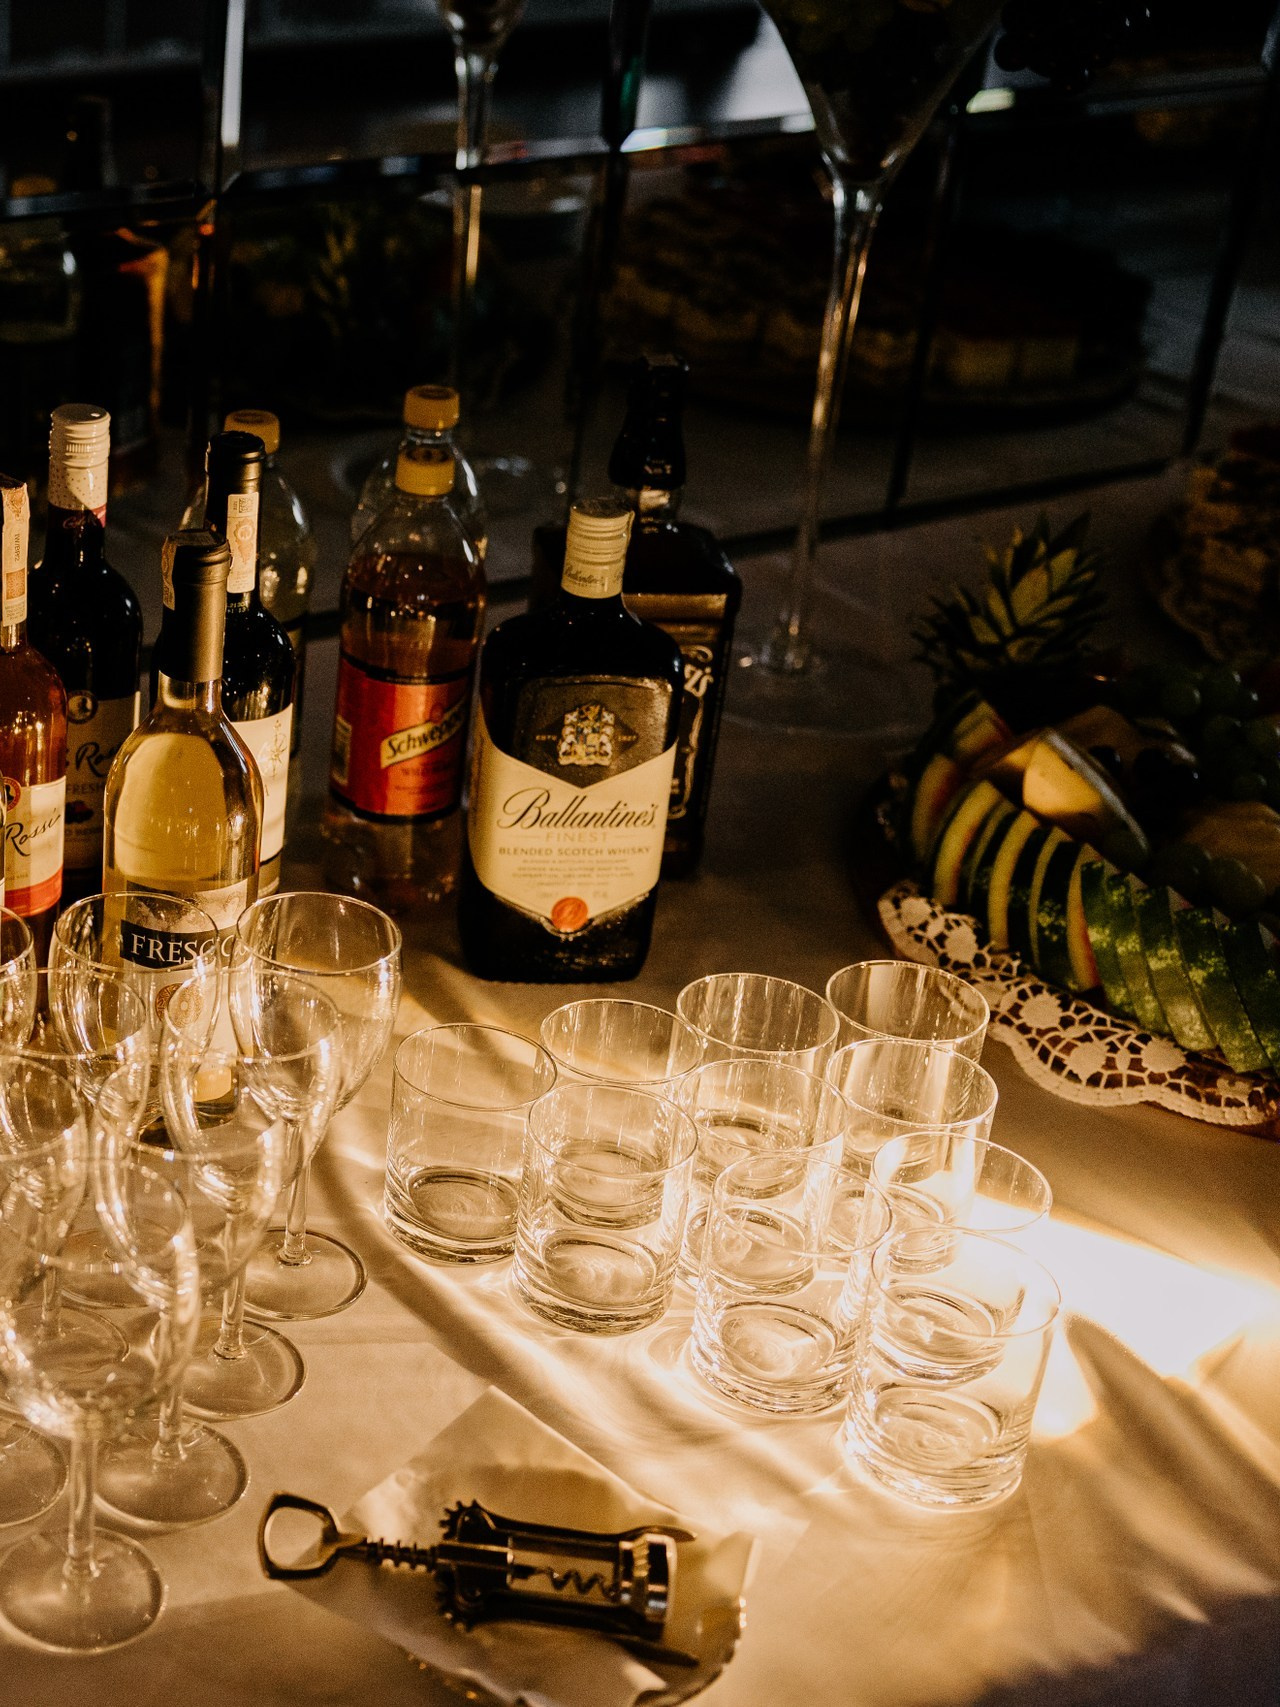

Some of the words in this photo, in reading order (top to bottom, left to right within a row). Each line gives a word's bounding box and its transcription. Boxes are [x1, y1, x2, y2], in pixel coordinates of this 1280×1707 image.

[497, 787, 658, 829] Ballantine's
[6, 808, 61, 857] Rossi
[545, 832, 608, 843] FINEST
[499, 847, 553, 855] BLENDED
[558, 847, 603, 855] SCOTCH
[608, 847, 650, 855] WHISKY
